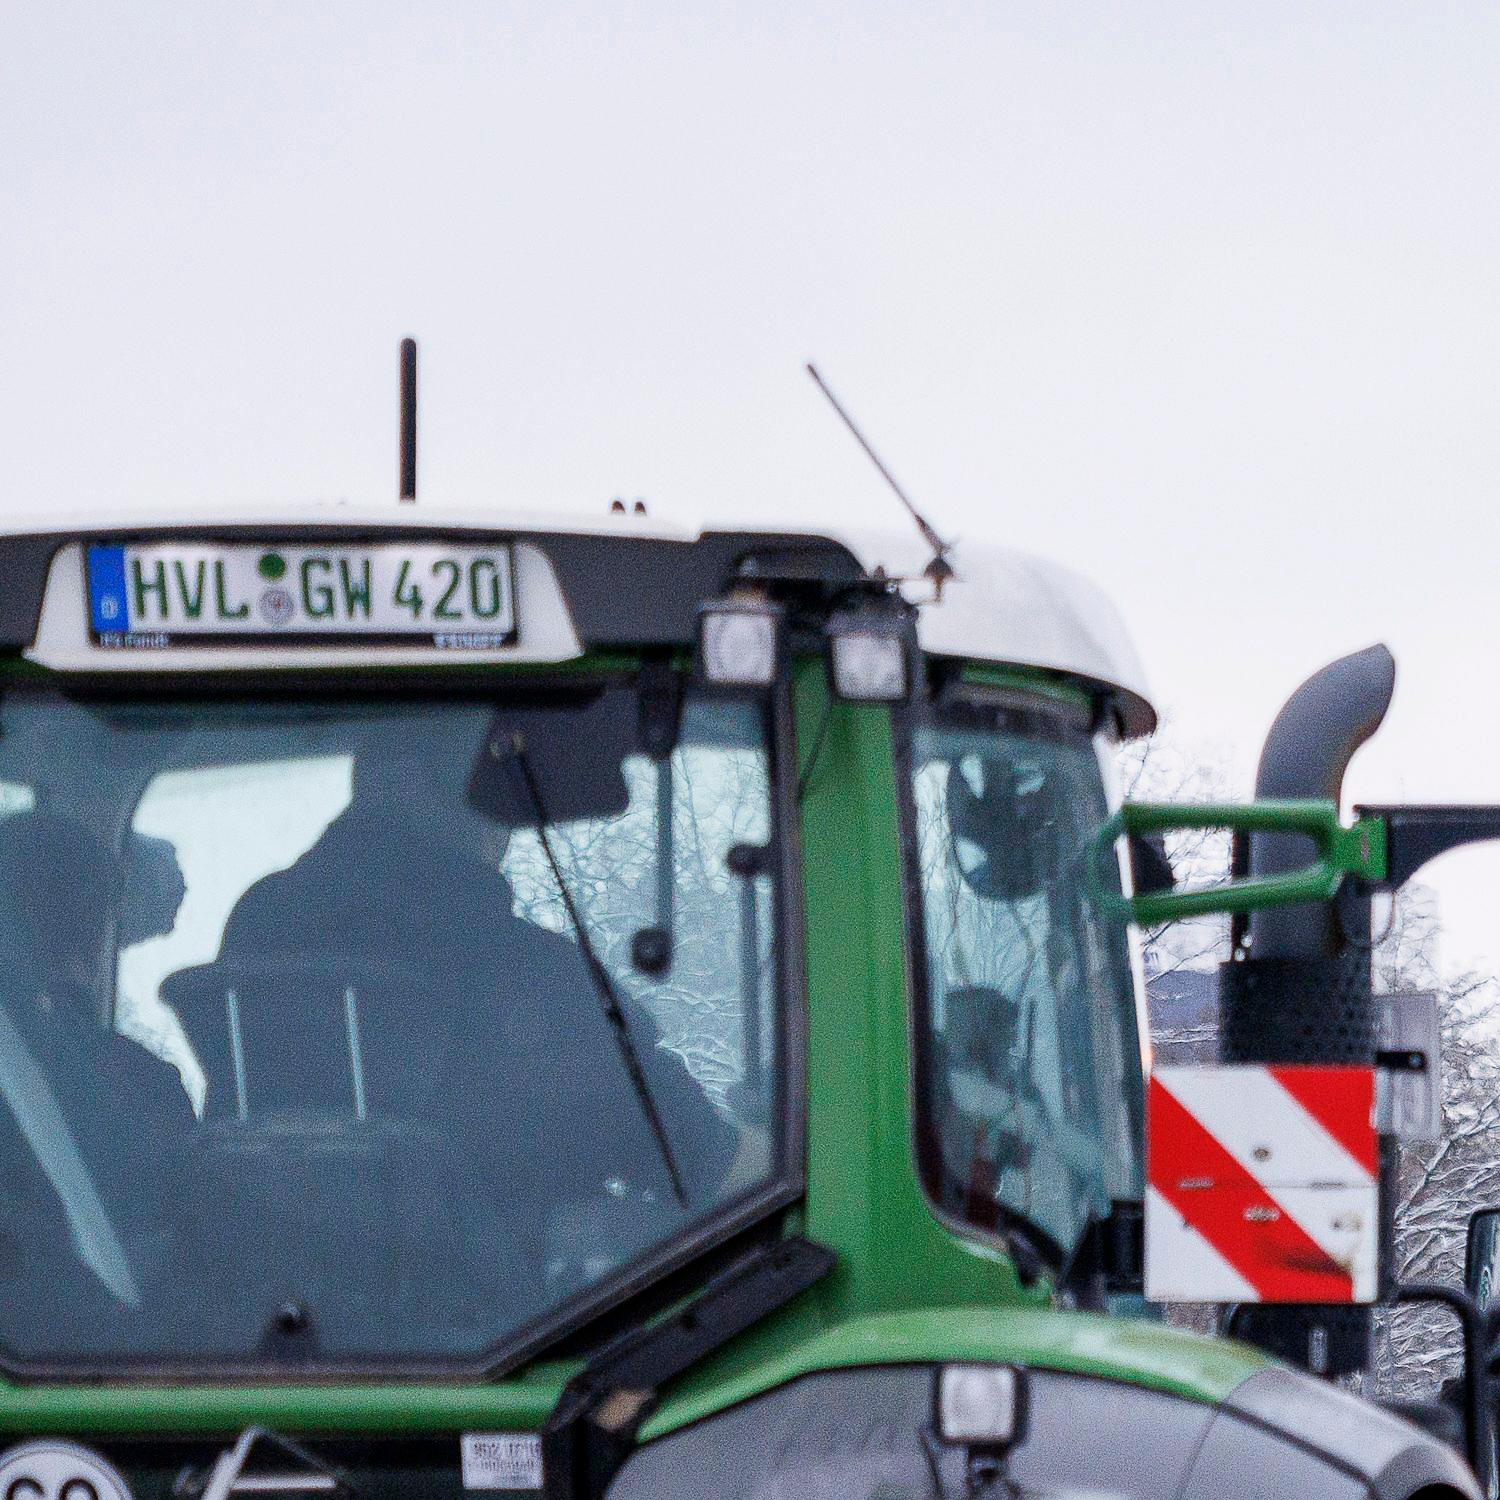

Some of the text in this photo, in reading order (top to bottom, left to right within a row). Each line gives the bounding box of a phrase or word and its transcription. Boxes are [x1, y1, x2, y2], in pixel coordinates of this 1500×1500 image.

[133, 560, 250, 620] HVL
[300, 558, 373, 619] GW
[392, 558, 500, 619] 420
